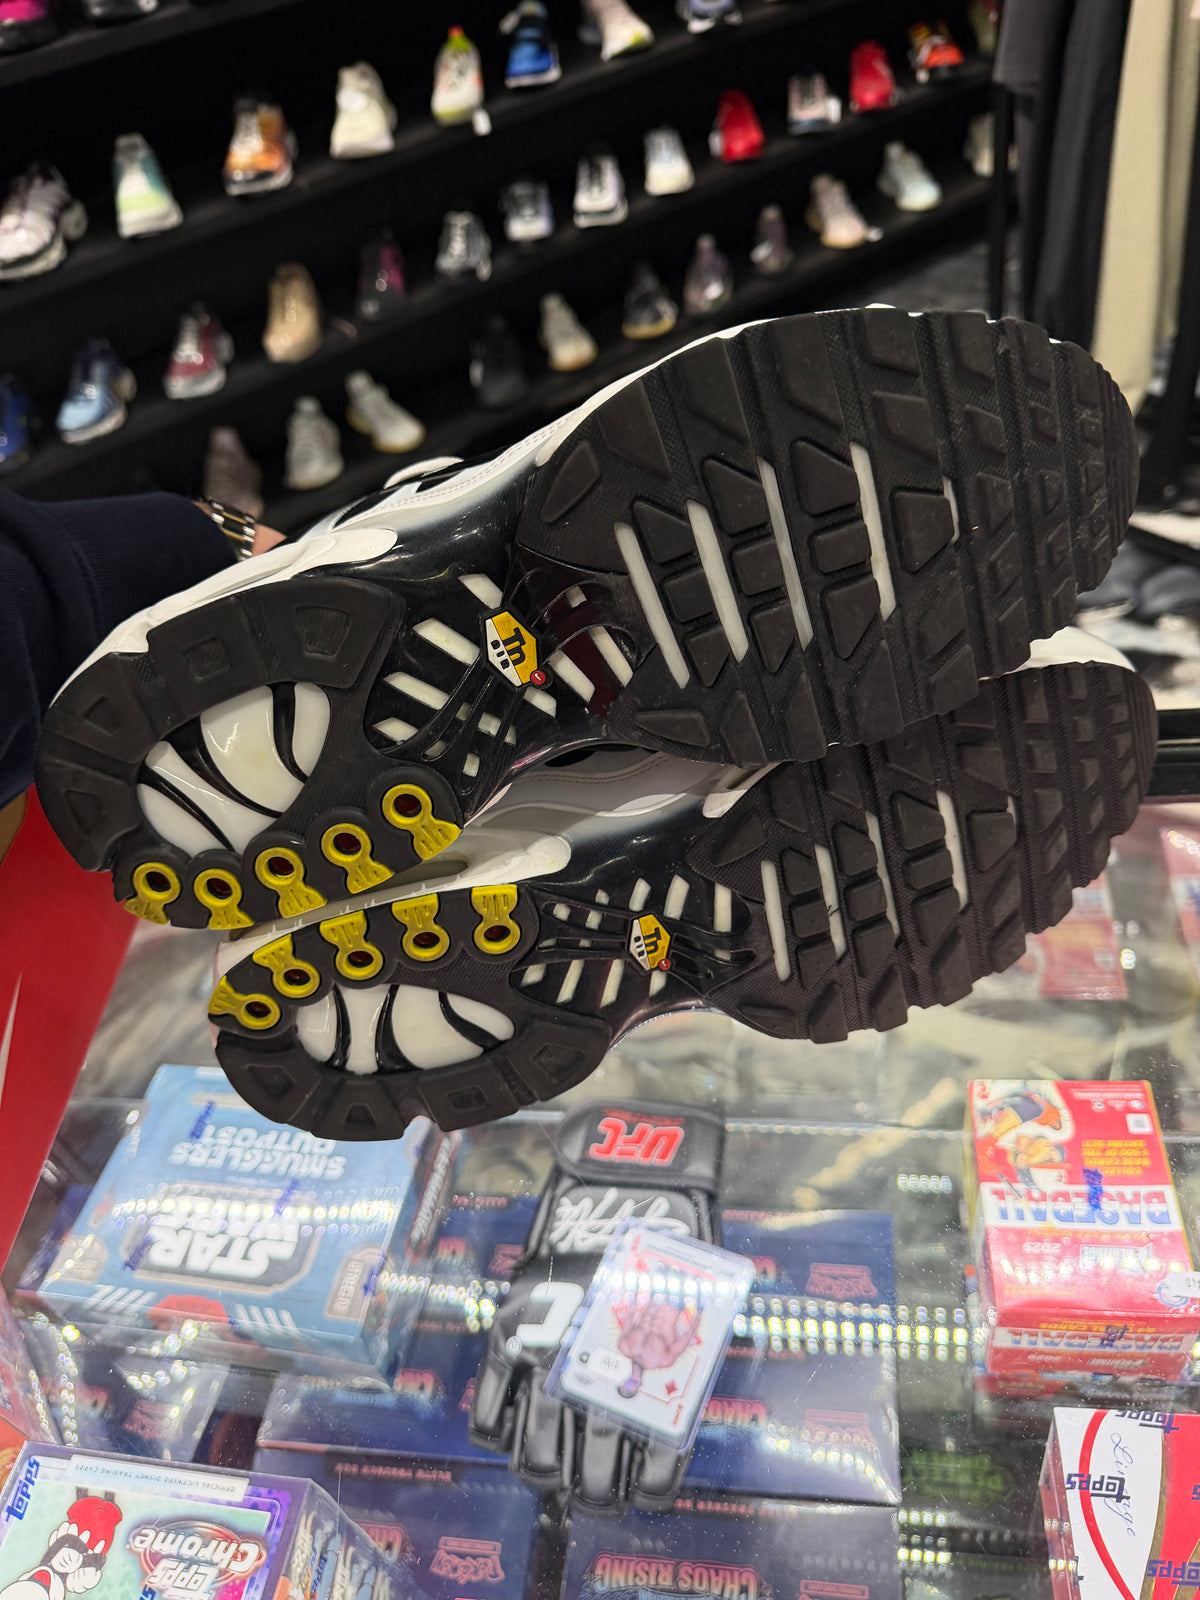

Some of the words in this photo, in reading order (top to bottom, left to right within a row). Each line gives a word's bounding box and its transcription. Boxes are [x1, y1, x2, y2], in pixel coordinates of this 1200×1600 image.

[202, 1124, 336, 1155] OUTPOST
[588, 1117, 685, 1167] UFC
[168, 1142, 347, 1181] SMUGGLERS
[990, 1187, 1172, 1226] BASEBALL
[149, 1226, 298, 1279] STAR
[1008, 1328, 1184, 1351] BASEBALL
[703, 1398, 767, 1428] CHAO
[1104, 1432, 1137, 1537] Liage
[133, 1527, 260, 1573] Chrome
[594, 1556, 675, 1594] RISING
[679, 1562, 759, 1600] CHAOS
